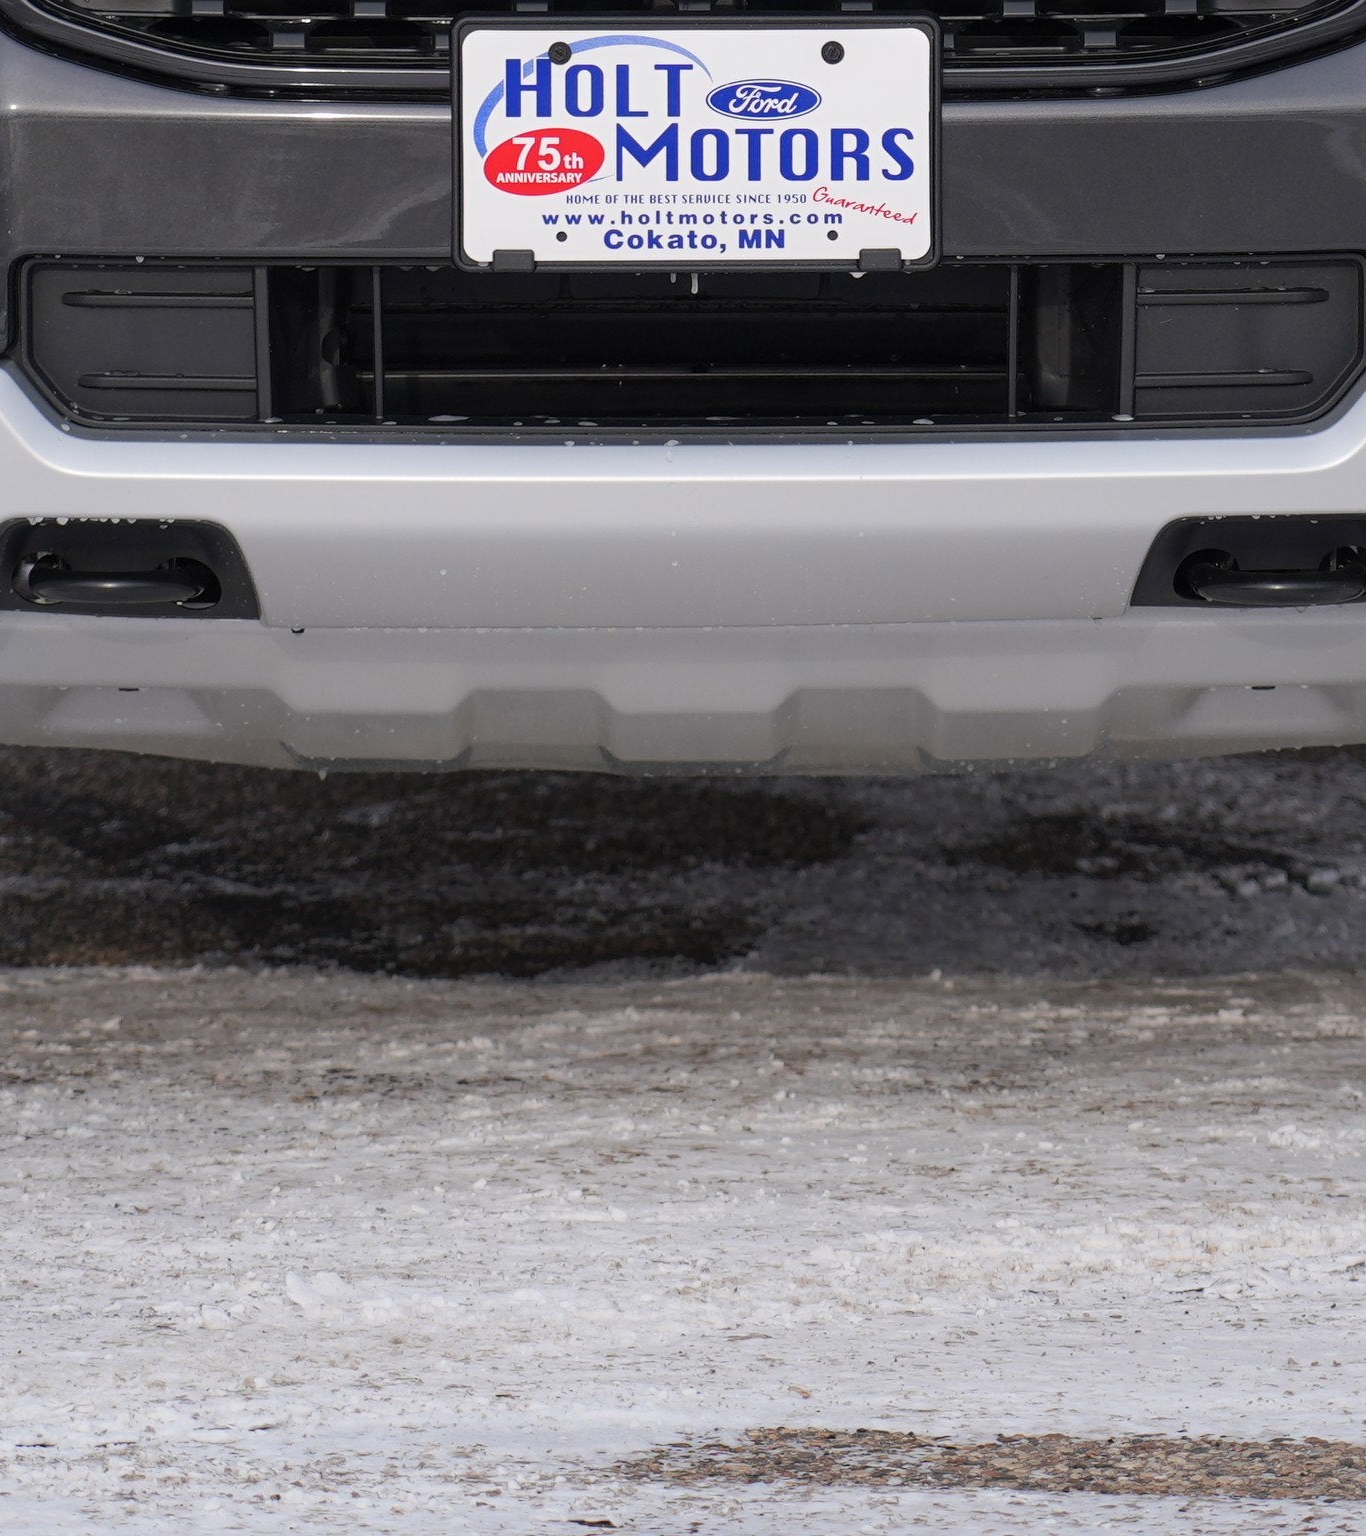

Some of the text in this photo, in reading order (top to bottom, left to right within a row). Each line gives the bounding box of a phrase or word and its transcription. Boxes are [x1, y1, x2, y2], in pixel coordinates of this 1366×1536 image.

[504, 58, 694, 118] HOLT
[728, 84, 799, 114] Ford
[512, 136, 584, 171] 75th
[615, 122, 915, 182] MOTORS
[496, 172, 583, 184] ANNIVERSARY
[566, 193, 807, 205] HOME OF THE BEST SERVICE SINCE 1950
[812, 186, 918, 225] Guaranteed
[542, 210, 843, 225] www.holtmotors.com
[603, 229, 785, 253] Cokato, MN
